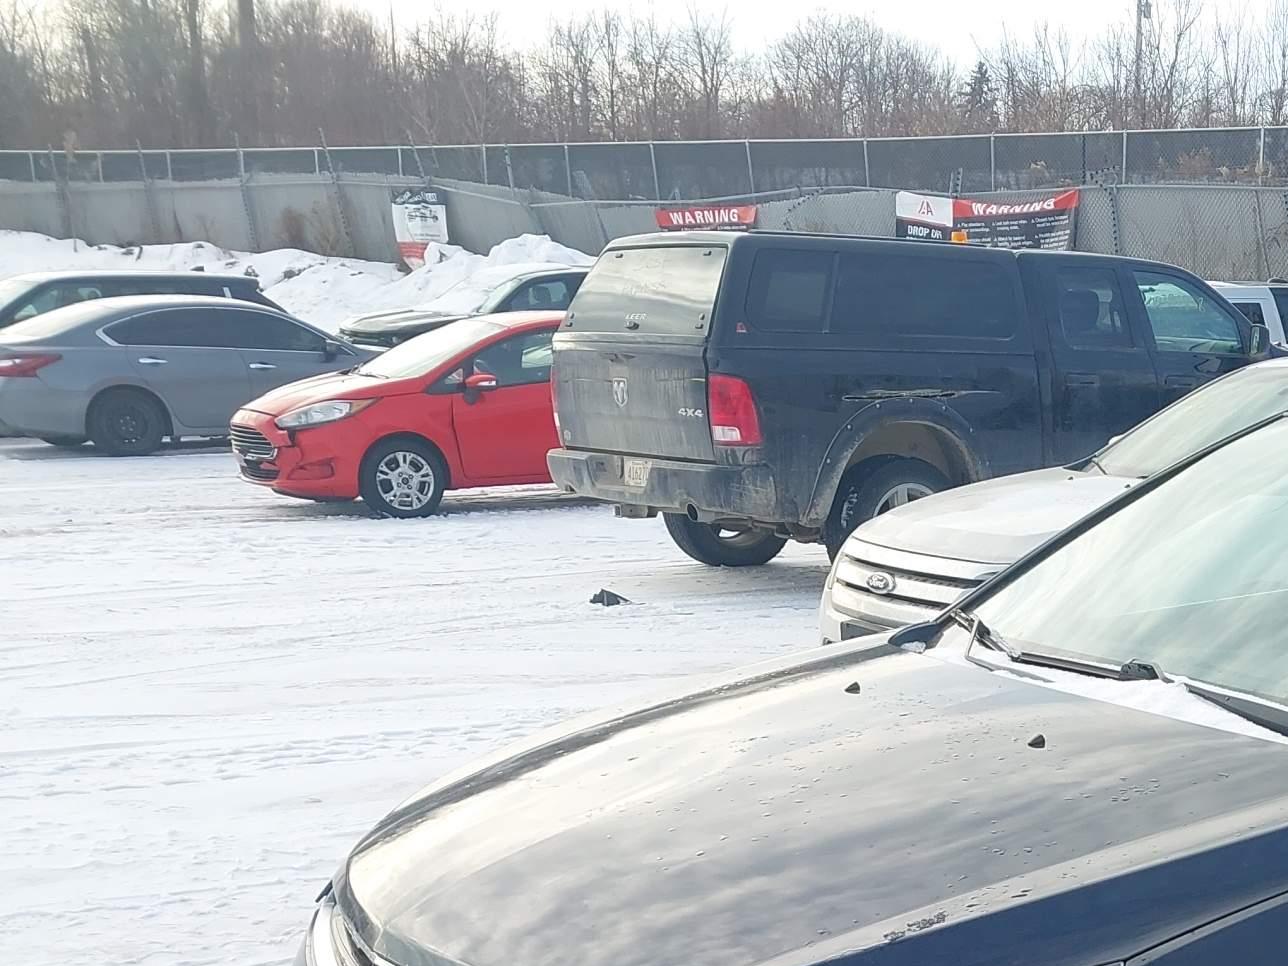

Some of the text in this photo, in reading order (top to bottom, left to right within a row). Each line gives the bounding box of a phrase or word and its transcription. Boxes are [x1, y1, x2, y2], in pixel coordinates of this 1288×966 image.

[971, 198, 1056, 216] WARNING
[669, 208, 738, 225] WARNING
[907, 224, 930, 238] DROP
